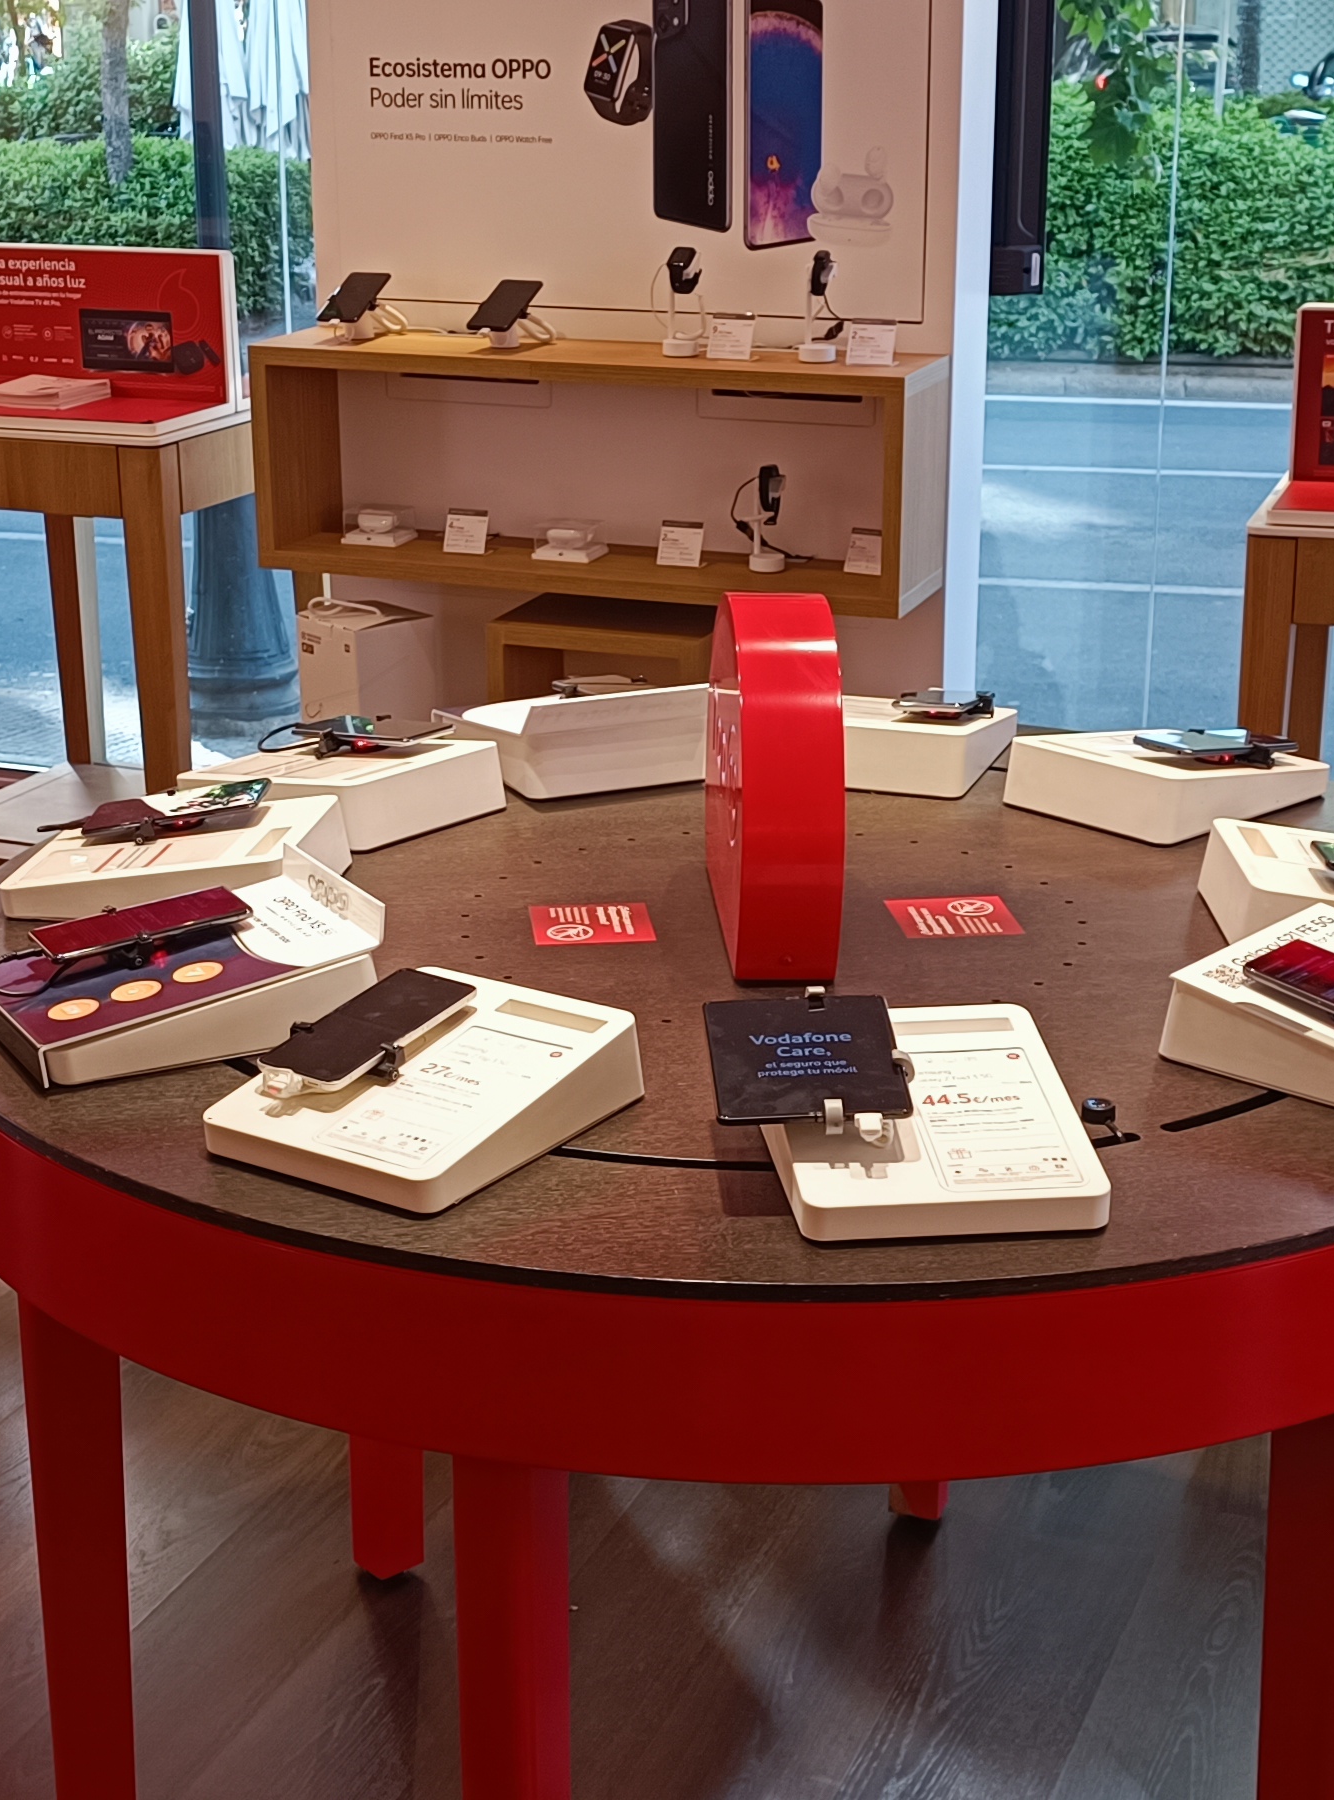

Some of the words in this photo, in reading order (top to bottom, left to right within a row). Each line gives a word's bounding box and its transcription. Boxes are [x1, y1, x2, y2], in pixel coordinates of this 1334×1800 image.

[369, 57, 486, 79] Ecosistema
[491, 58, 551, 80] OPPO
[370, 87, 425, 108] Poder
[429, 88, 456, 109] sin
[461, 88, 524, 110] límites
[370, 131, 389, 140] OPPO
[390, 132, 404, 140] Find
[415, 133, 426, 141] Pro
[434, 133, 453, 142] OPPO
[495, 135, 515, 143] OPPO
[515, 135, 537, 144] Watch
[538, 135, 553, 144] Free
[8, 258, 75, 272] experiencia
[27, 276, 33, 286] a
[36, 274, 64, 287] años
[66, 275, 86, 289] luz
[749, 1032, 852, 1045] Vodafone
[776, 1046, 831, 1057] Care,
[780, 1061, 821, 1069] seguro
[757, 1069, 804, 1078] protege
[823, 1066, 858, 1074] móvil
